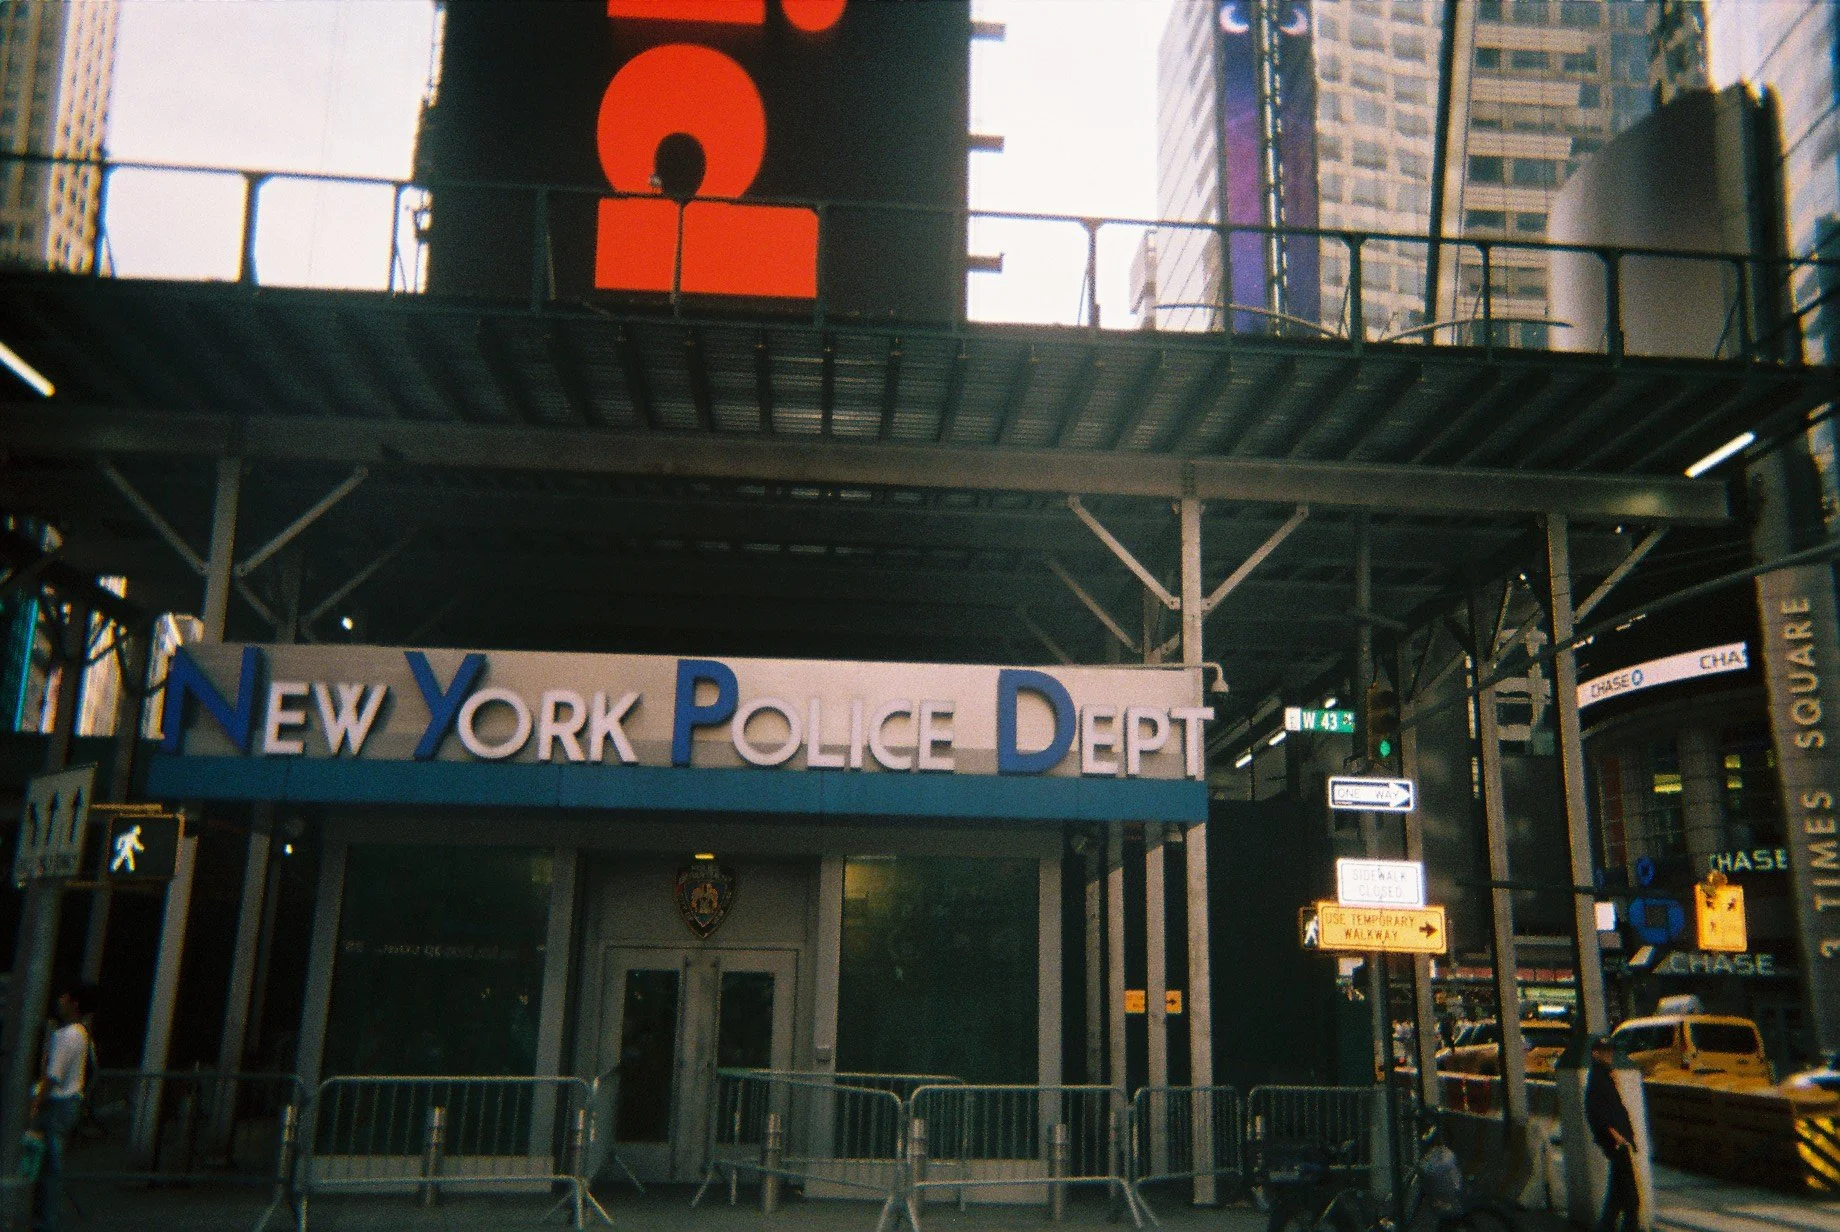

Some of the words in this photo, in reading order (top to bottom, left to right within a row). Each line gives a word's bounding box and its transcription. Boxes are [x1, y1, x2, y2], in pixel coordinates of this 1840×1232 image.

[1700, 651, 1746, 669] CHA
[1780, 598, 1825, 749] SQUARE
[1590, 674, 1630, 698] CHASE
[163, 644, 388, 757] NEW
[404, 650, 640, 765] YORK
[671, 658, 955, 774] POLICE
[997, 668, 1214, 779] DEPT
[1302, 711, 1316, 730] W
[1321, 711, 1338, 731] 43
[1337, 787, 1361, 799] ONE
[1375, 789, 1400, 800] WAY
[1801, 789, 1840, 913] TIMES
[1352, 868, 1407, 883] SIDEWALK
[1358, 884, 1403, 898] CLOSED
[1324, 912, 1345, 925] USE
[1352, 914, 1415, 927] TEMPORARY
[1344, 929, 1398, 940] WALKWAY
[1670, 952, 1776, 976] CHASE
